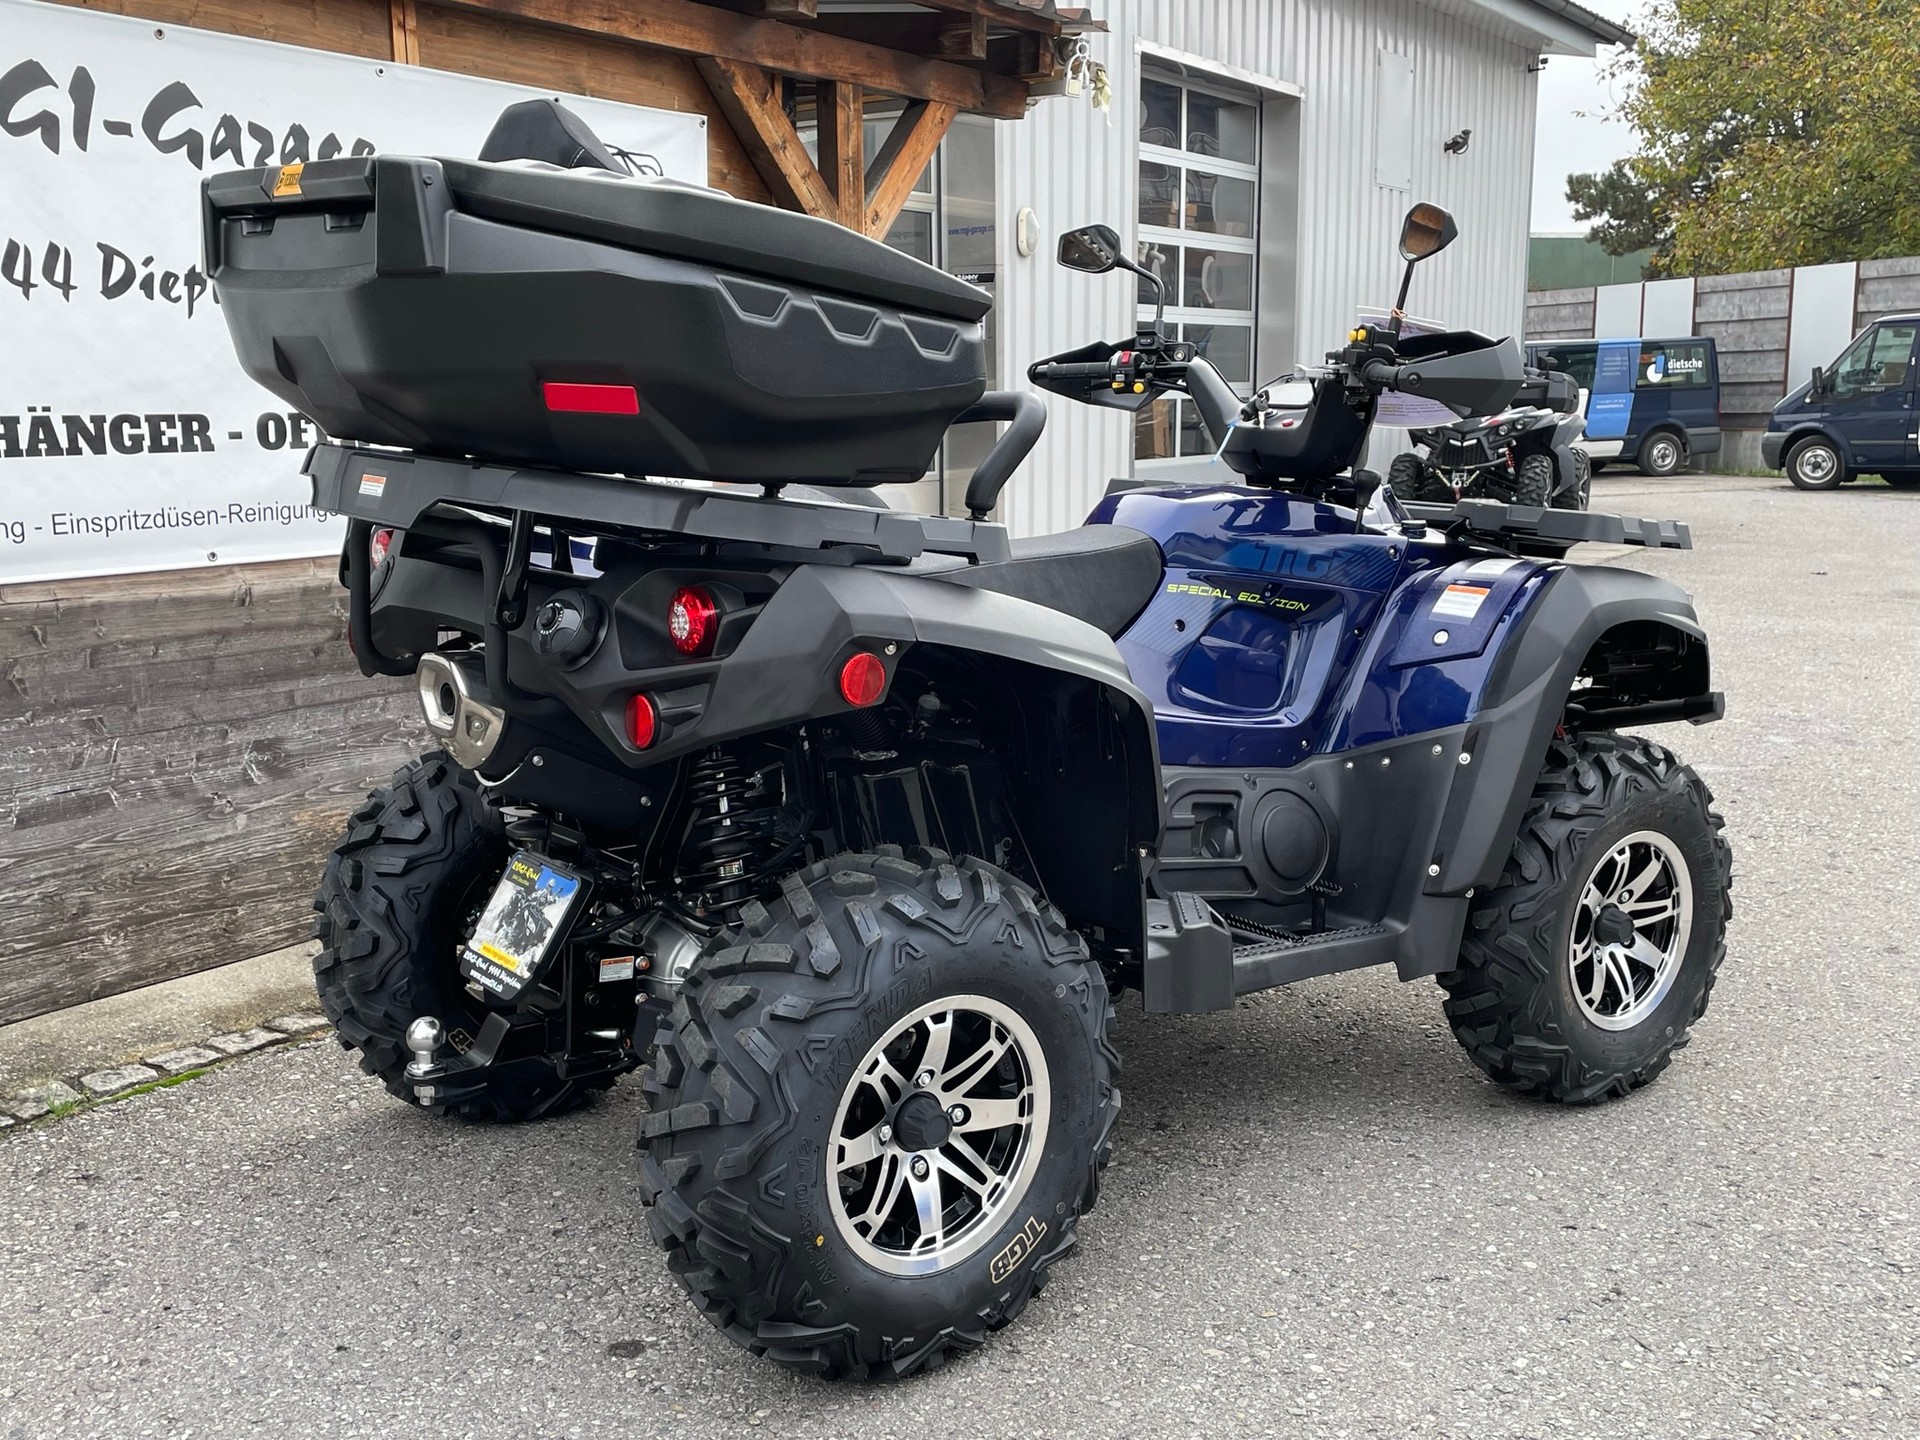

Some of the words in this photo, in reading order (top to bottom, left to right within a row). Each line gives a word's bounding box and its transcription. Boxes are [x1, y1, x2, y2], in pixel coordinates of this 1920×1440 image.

[0, 237, 78, 303] 44
[96, 241, 221, 320] Diep
[1667, 357, 1703, 370] dietsche
[51, 500, 339, 537] Einspritzdüsen-Reinigung
[1166, 583, 1232, 599] SPECIAL
[821, 965, 933, 1093] KENDA
[990, 1216, 1048, 1284] TGB
